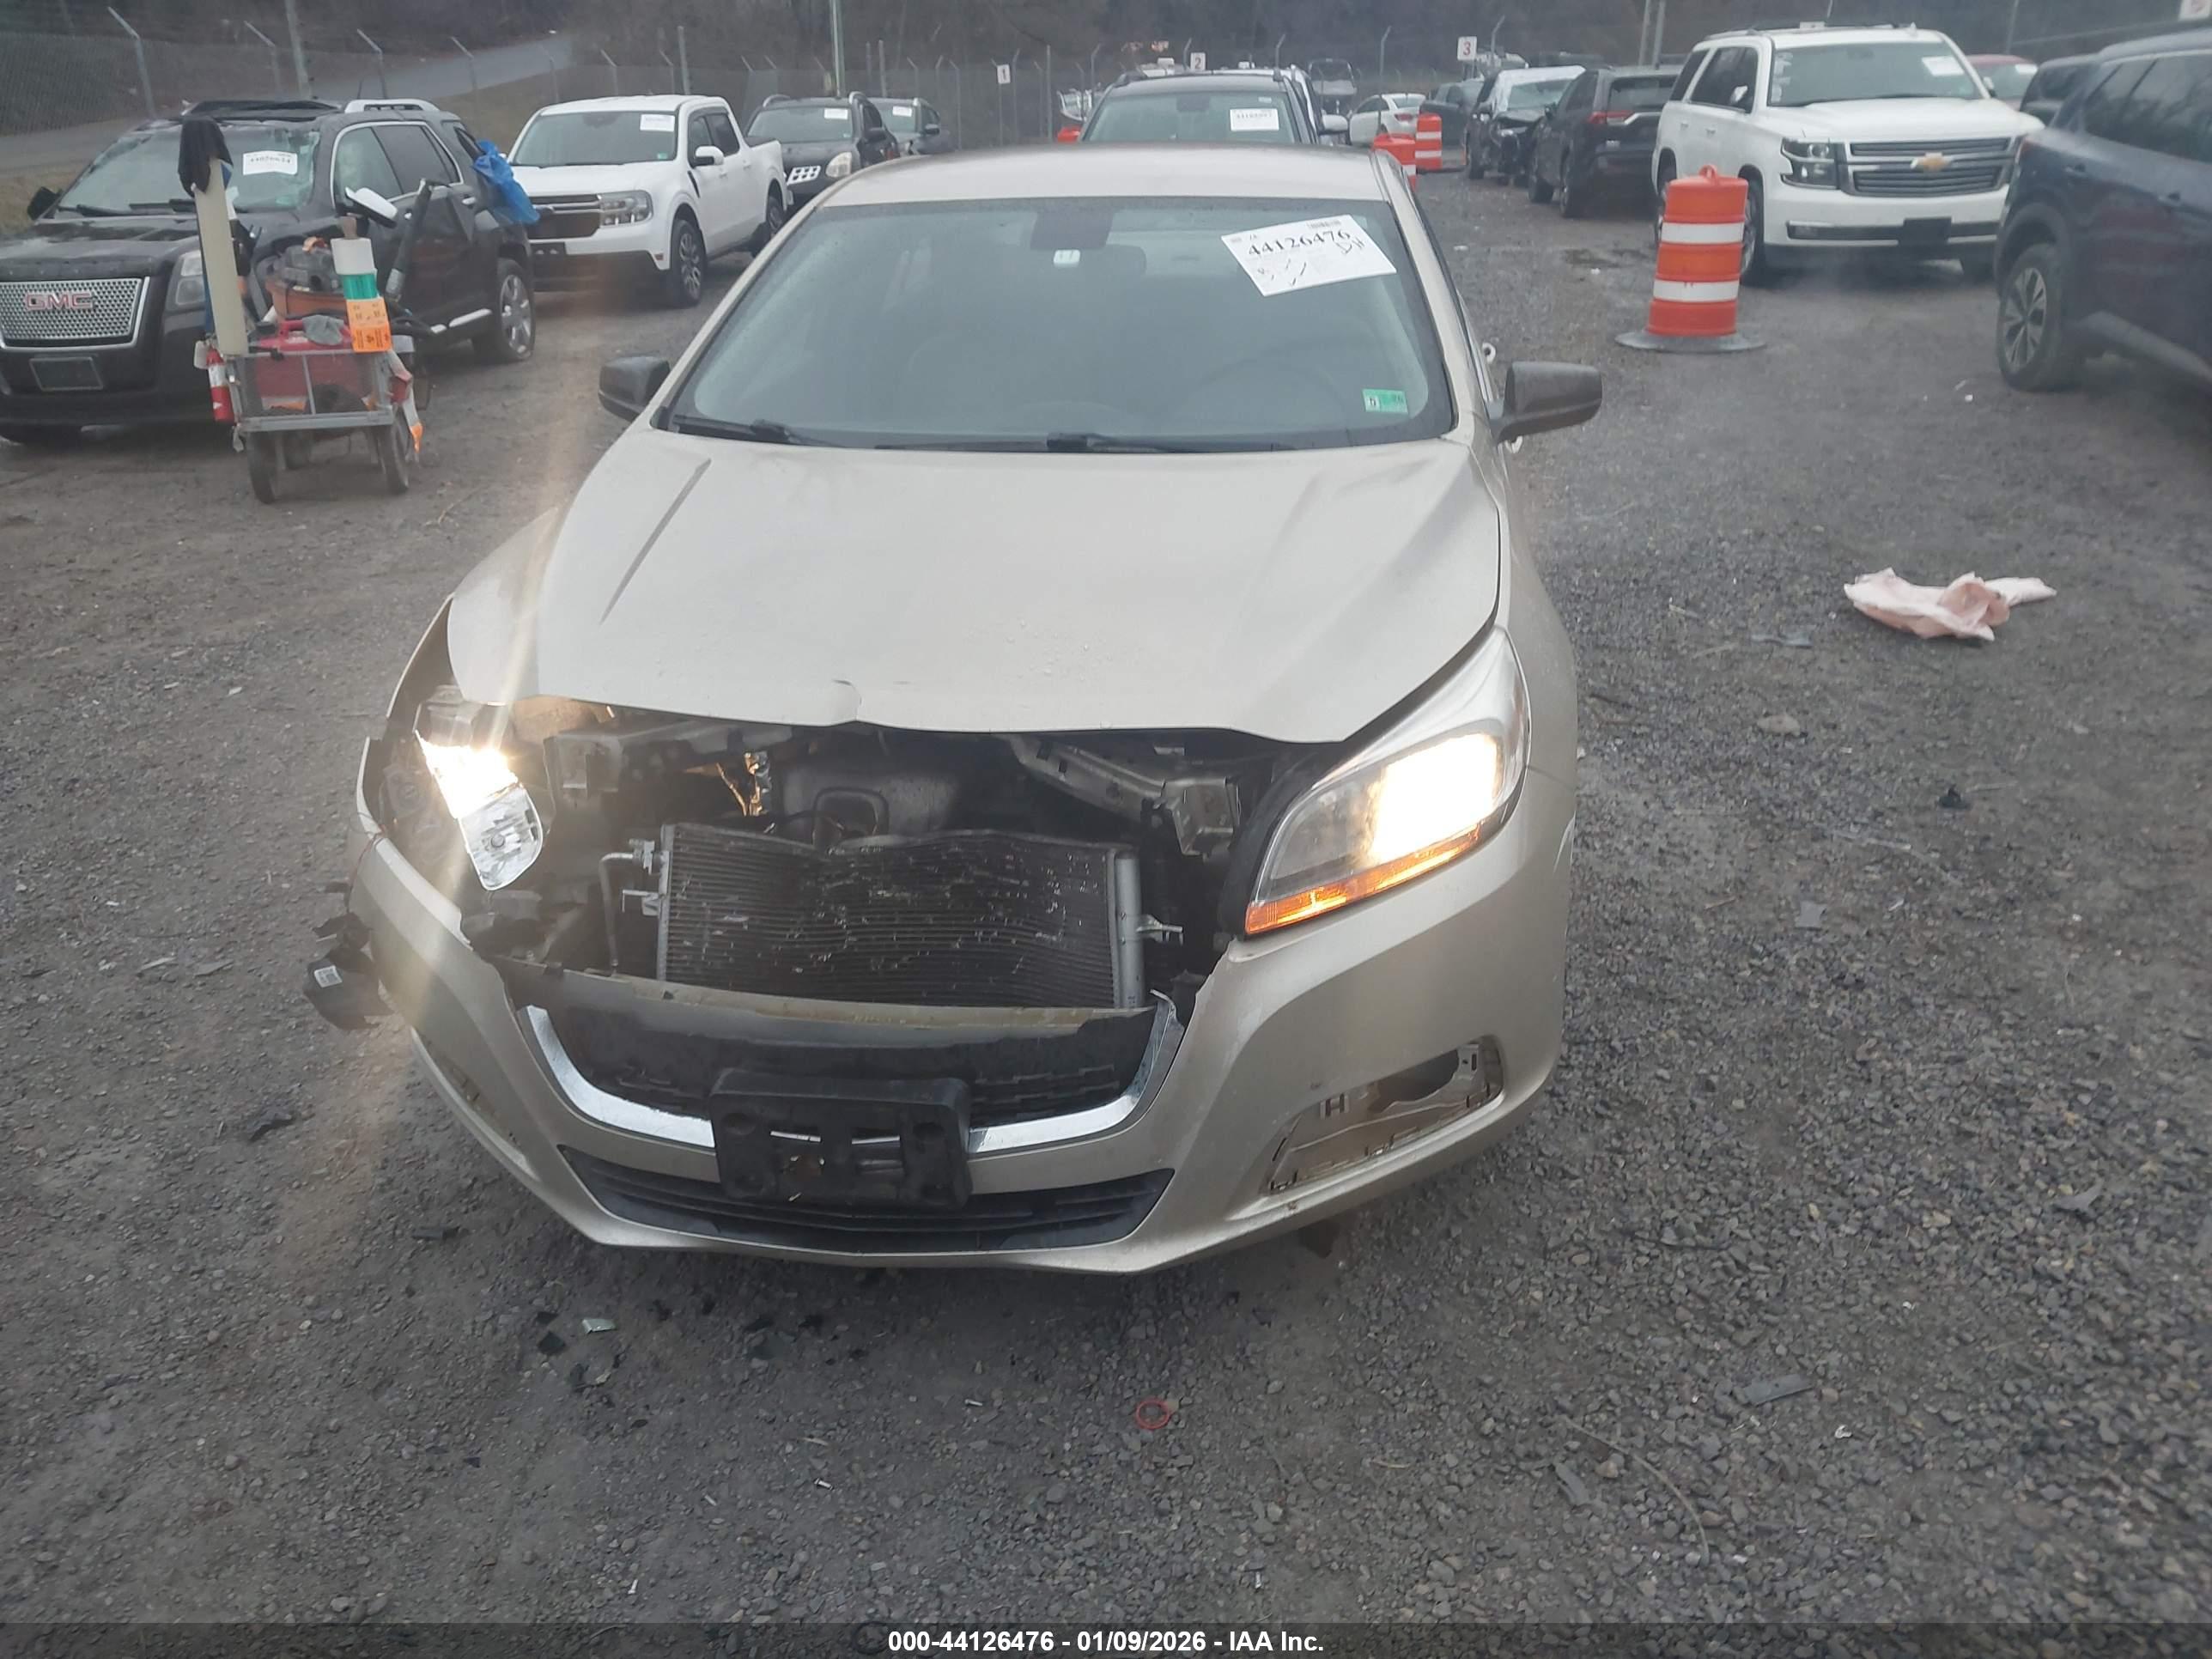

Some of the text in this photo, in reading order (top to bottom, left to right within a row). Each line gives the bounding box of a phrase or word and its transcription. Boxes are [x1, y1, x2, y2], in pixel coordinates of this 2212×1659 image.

[1462, 40, 1471, 56] 3
[1194, 57, 1202, 69] 2
[1249, 229, 1351, 255] 44126476
[26, 292, 93, 309] GMC
